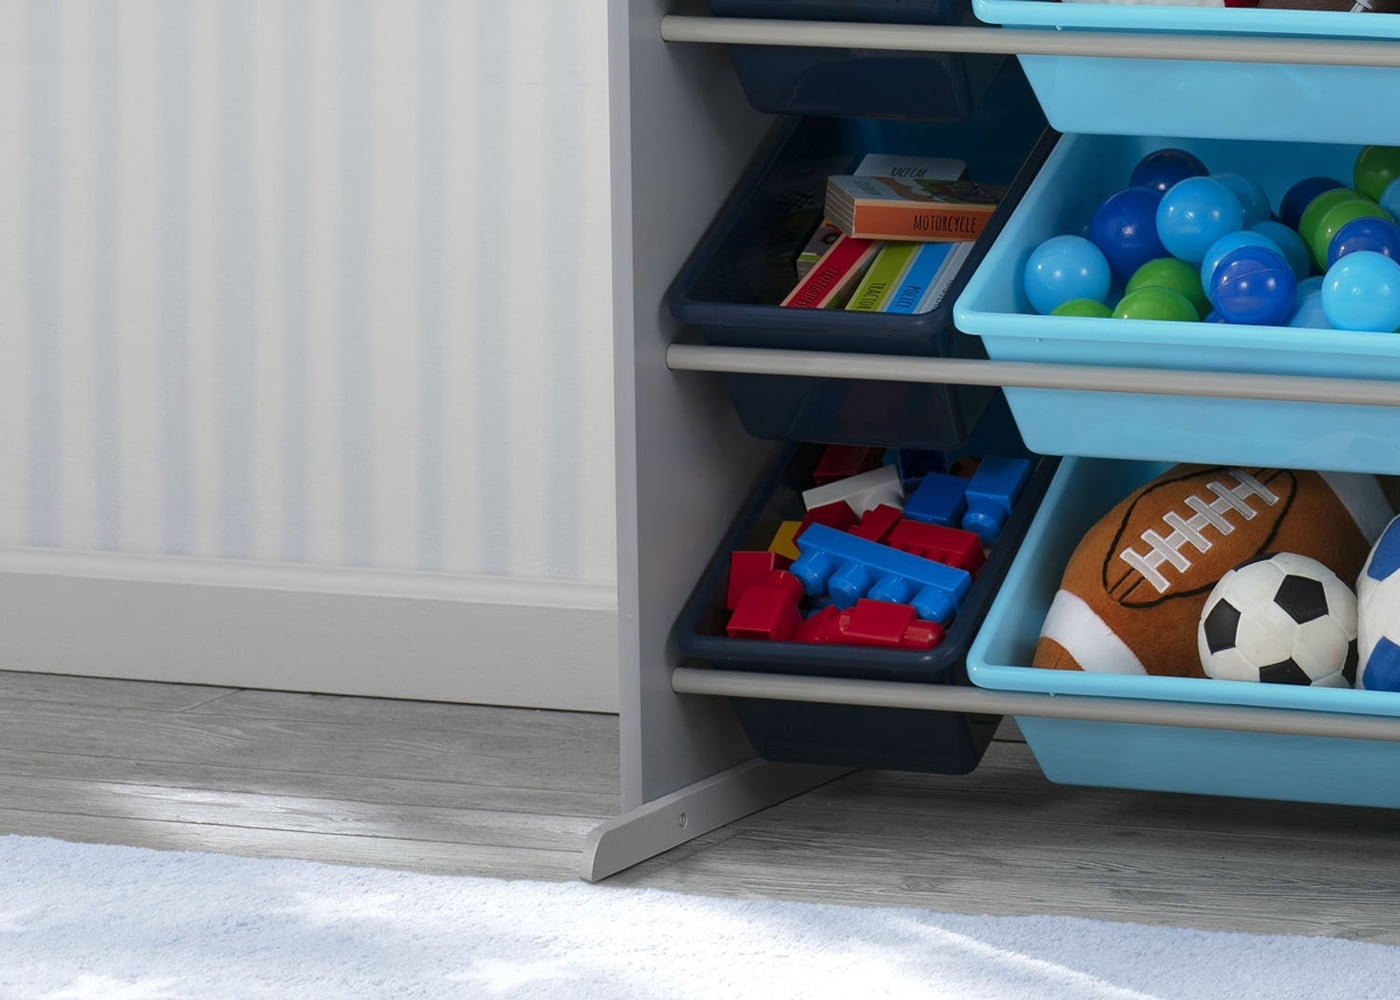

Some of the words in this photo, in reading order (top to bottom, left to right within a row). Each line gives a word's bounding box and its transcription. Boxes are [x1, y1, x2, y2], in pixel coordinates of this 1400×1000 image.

[912, 214, 977, 234] MOTORCYCLE
[857, 282, 887, 310] TRACTOR
[895, 285, 922, 309] POLICE
